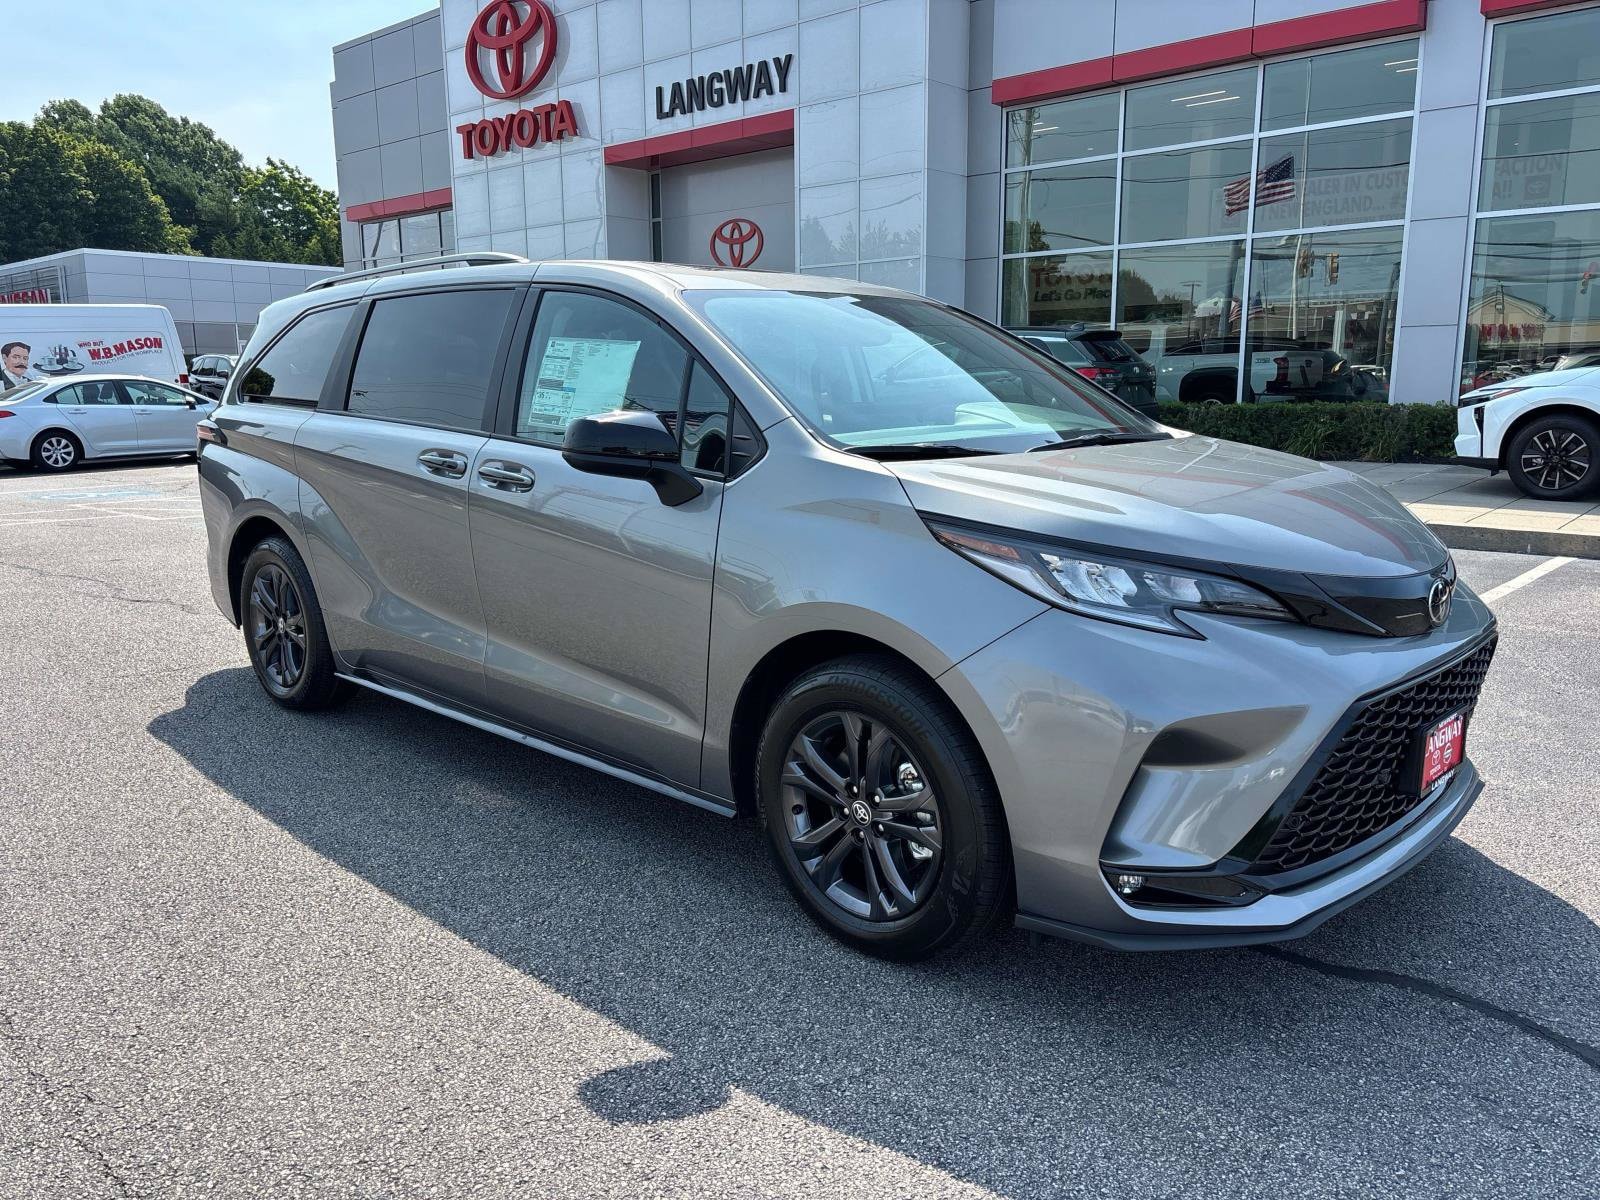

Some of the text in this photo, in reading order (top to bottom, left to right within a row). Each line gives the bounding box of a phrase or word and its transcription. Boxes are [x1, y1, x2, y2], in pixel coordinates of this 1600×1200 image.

[655, 54, 793, 120] LANGWAY
[456, 100, 578, 160] TOYOTA
[1064, 288, 1081, 301] Go
